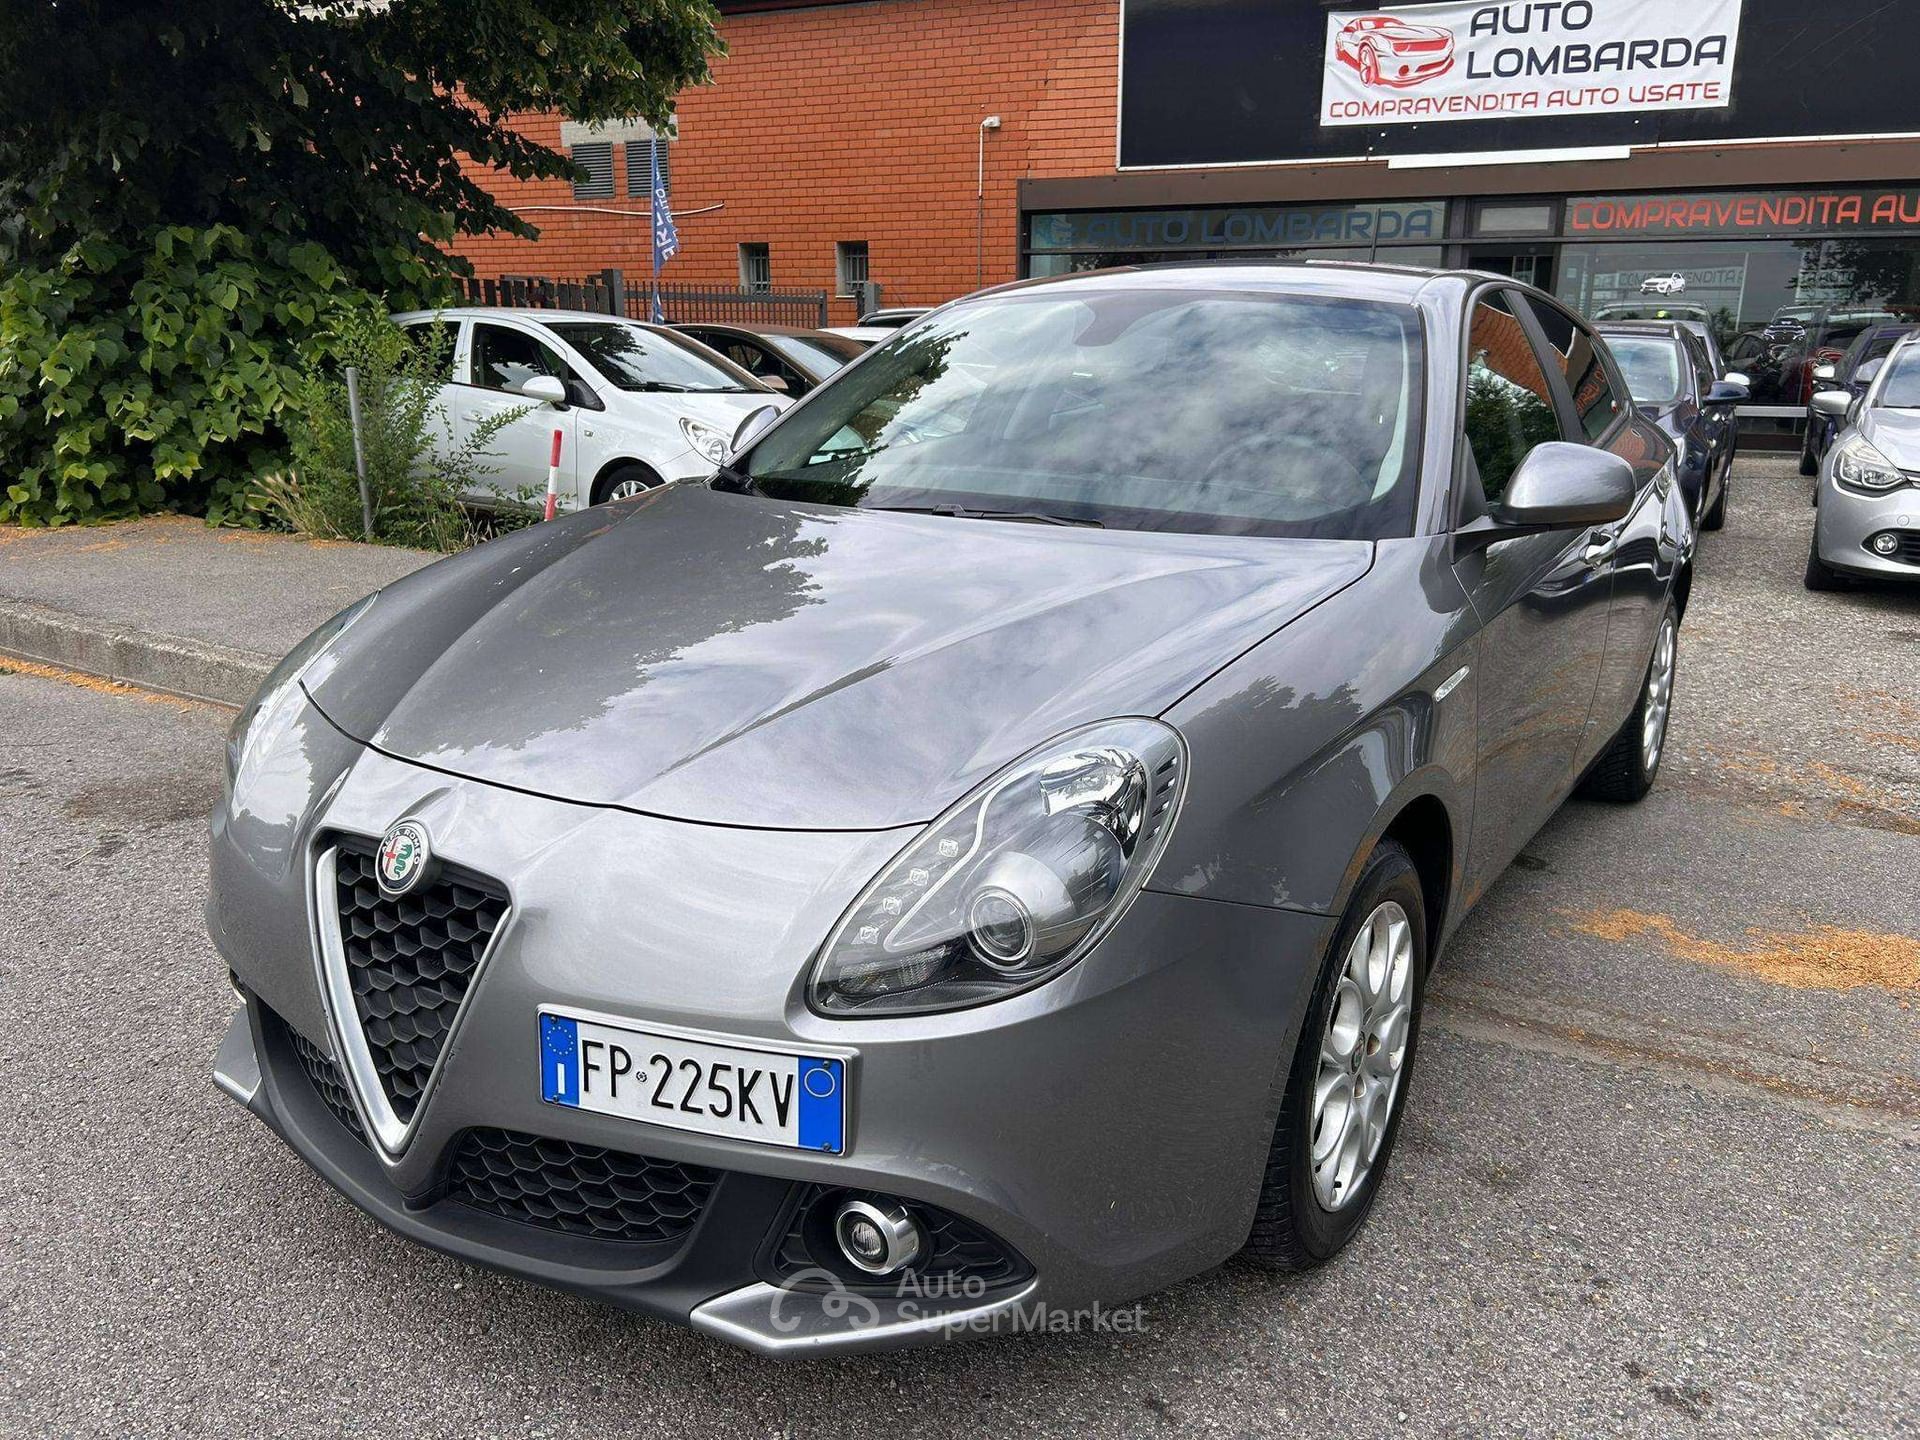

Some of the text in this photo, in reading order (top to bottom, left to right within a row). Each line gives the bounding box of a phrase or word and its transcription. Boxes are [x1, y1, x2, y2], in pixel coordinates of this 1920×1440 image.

[1470, 0, 1592, 37] AUTO
[1466, 35, 1727, 80] LOMBARDA
[1329, 82, 1721, 118] COMPRAVENDITA AUTO USATE
[1087, 209, 1433, 244] AUTO LOMBARDA
[1571, 195, 1862, 230] COMPRAVENDITA
[581, 1039, 633, 1098] FP
[649, 1054, 794, 1128] 225KV
